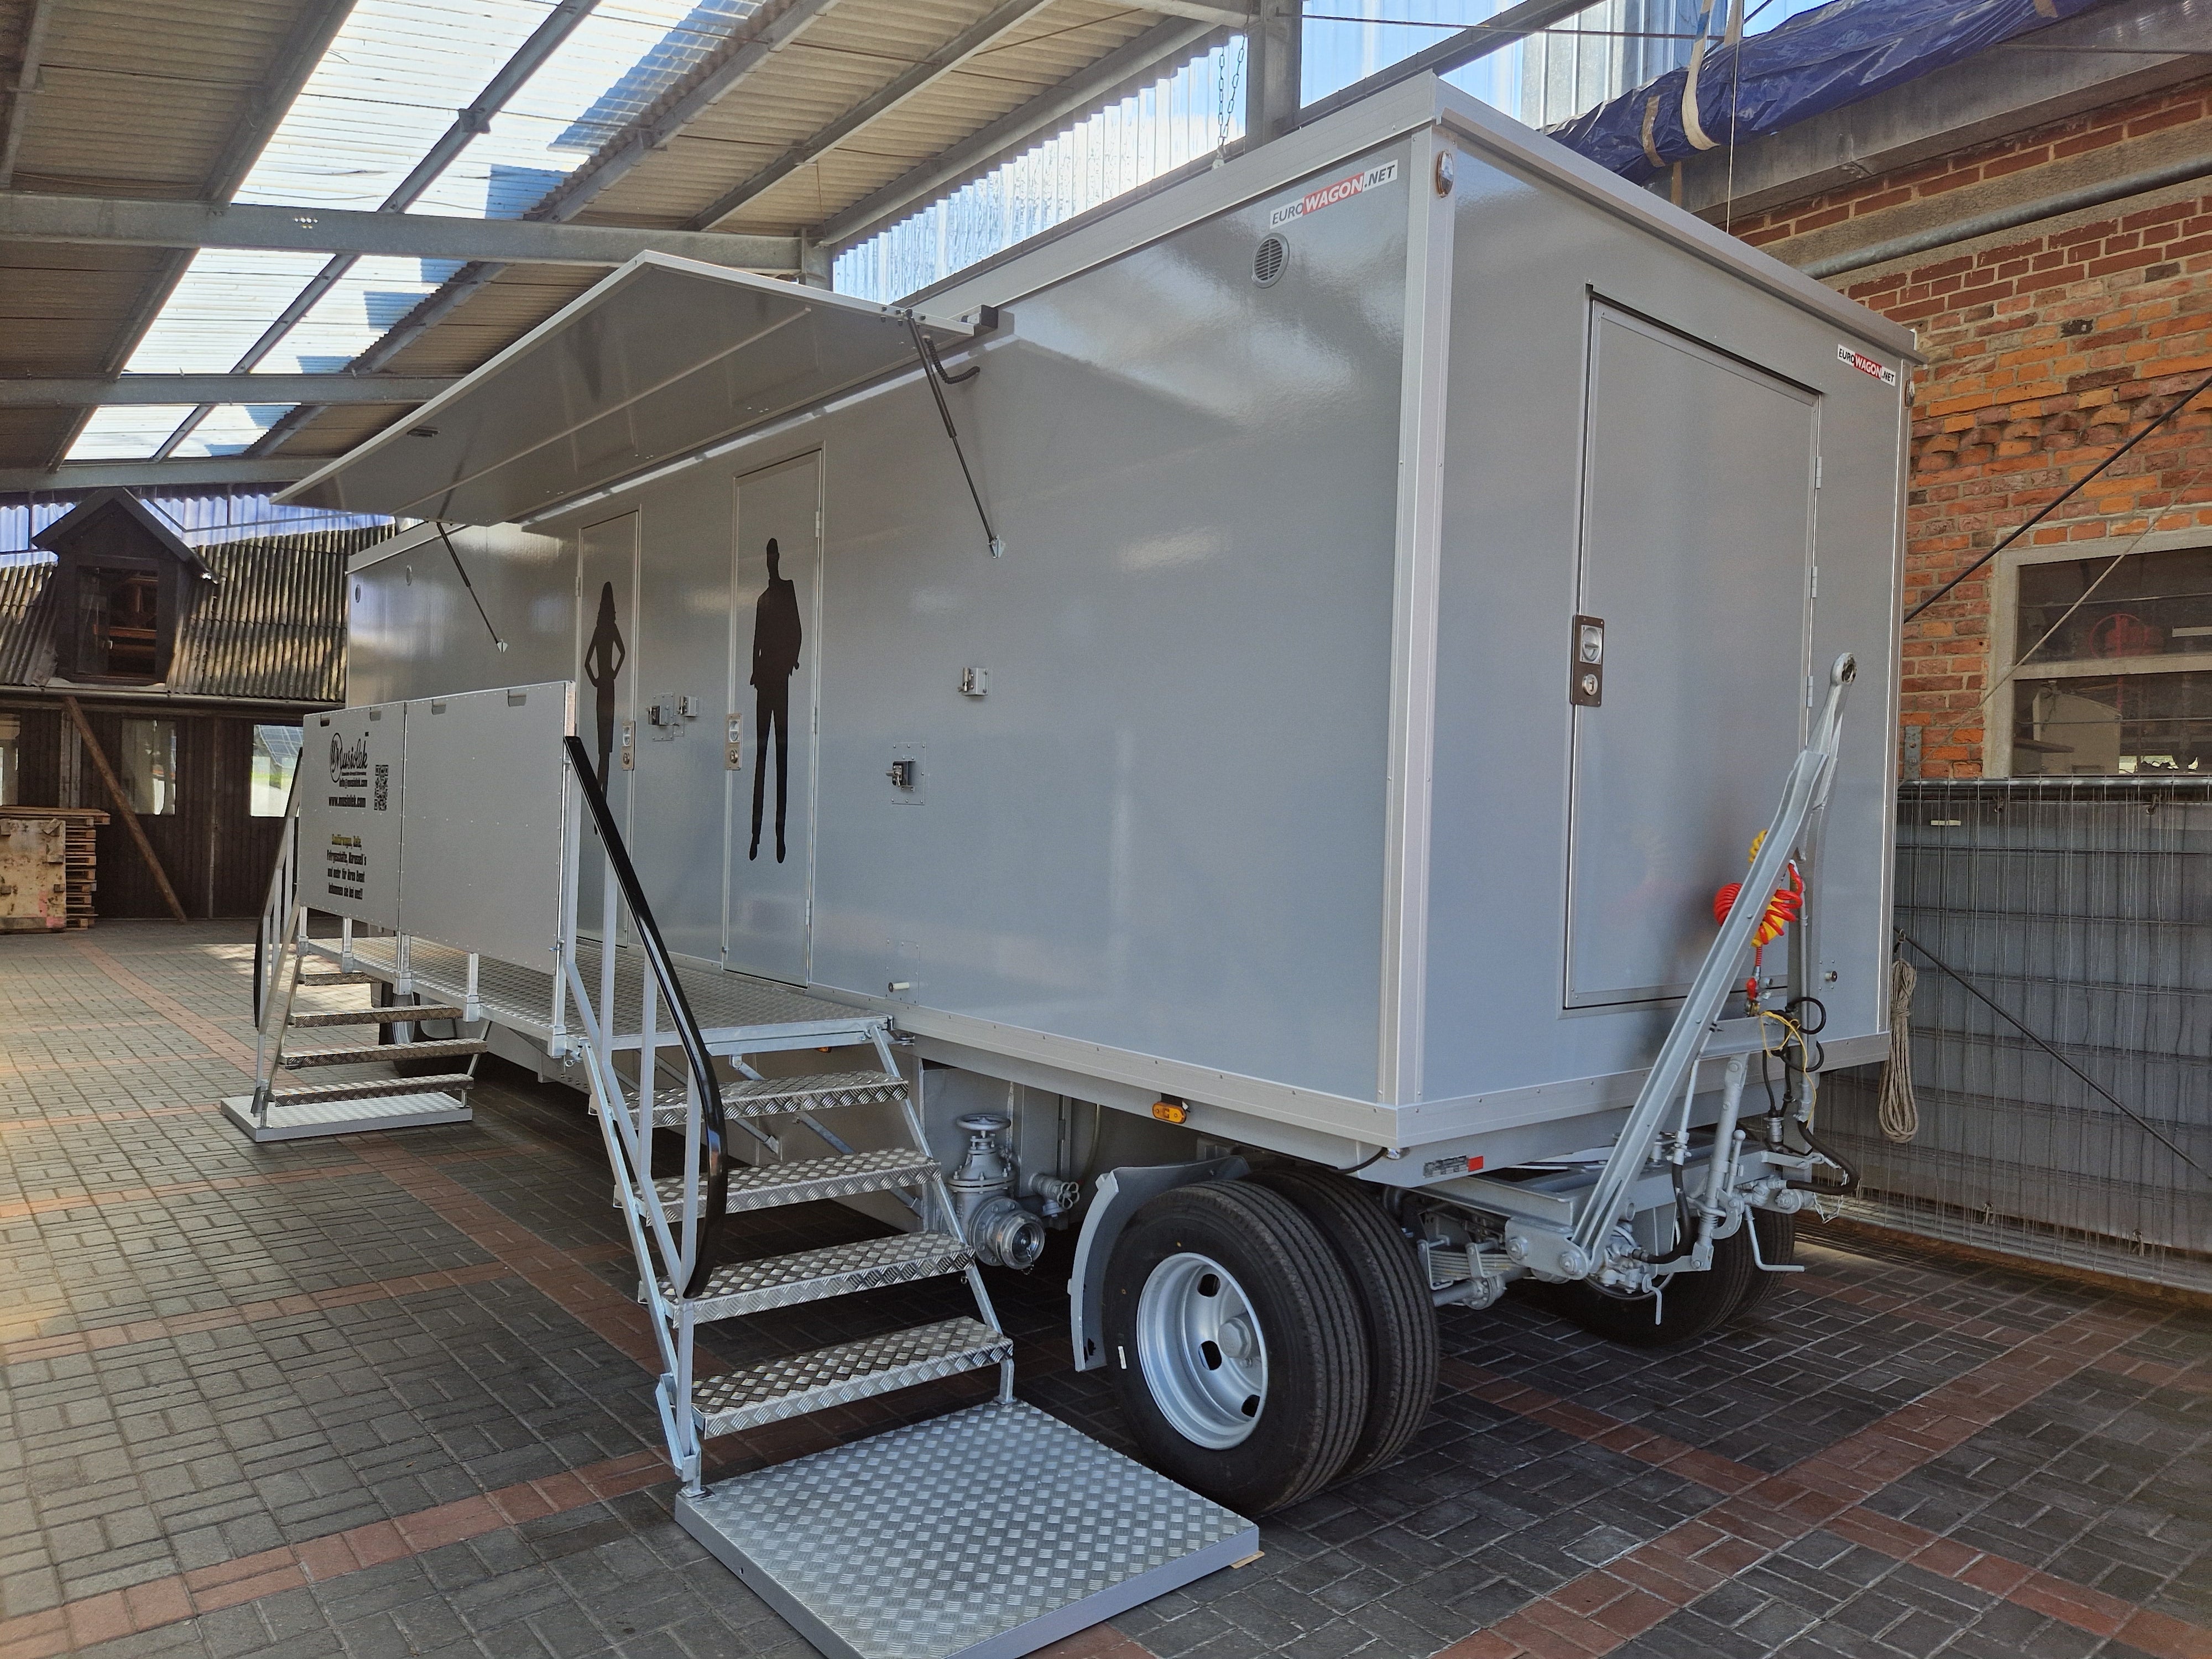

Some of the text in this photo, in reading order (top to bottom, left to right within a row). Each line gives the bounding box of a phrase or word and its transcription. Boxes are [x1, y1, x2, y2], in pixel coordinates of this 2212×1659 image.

[1272, 165, 1395, 225] EUROWAGON.NET
[1839, 348, 1895, 383] EUROWAGON.NET
[330, 738, 368, 773] Musiolek
[328, 794, 366, 808] www.musiolek.com
